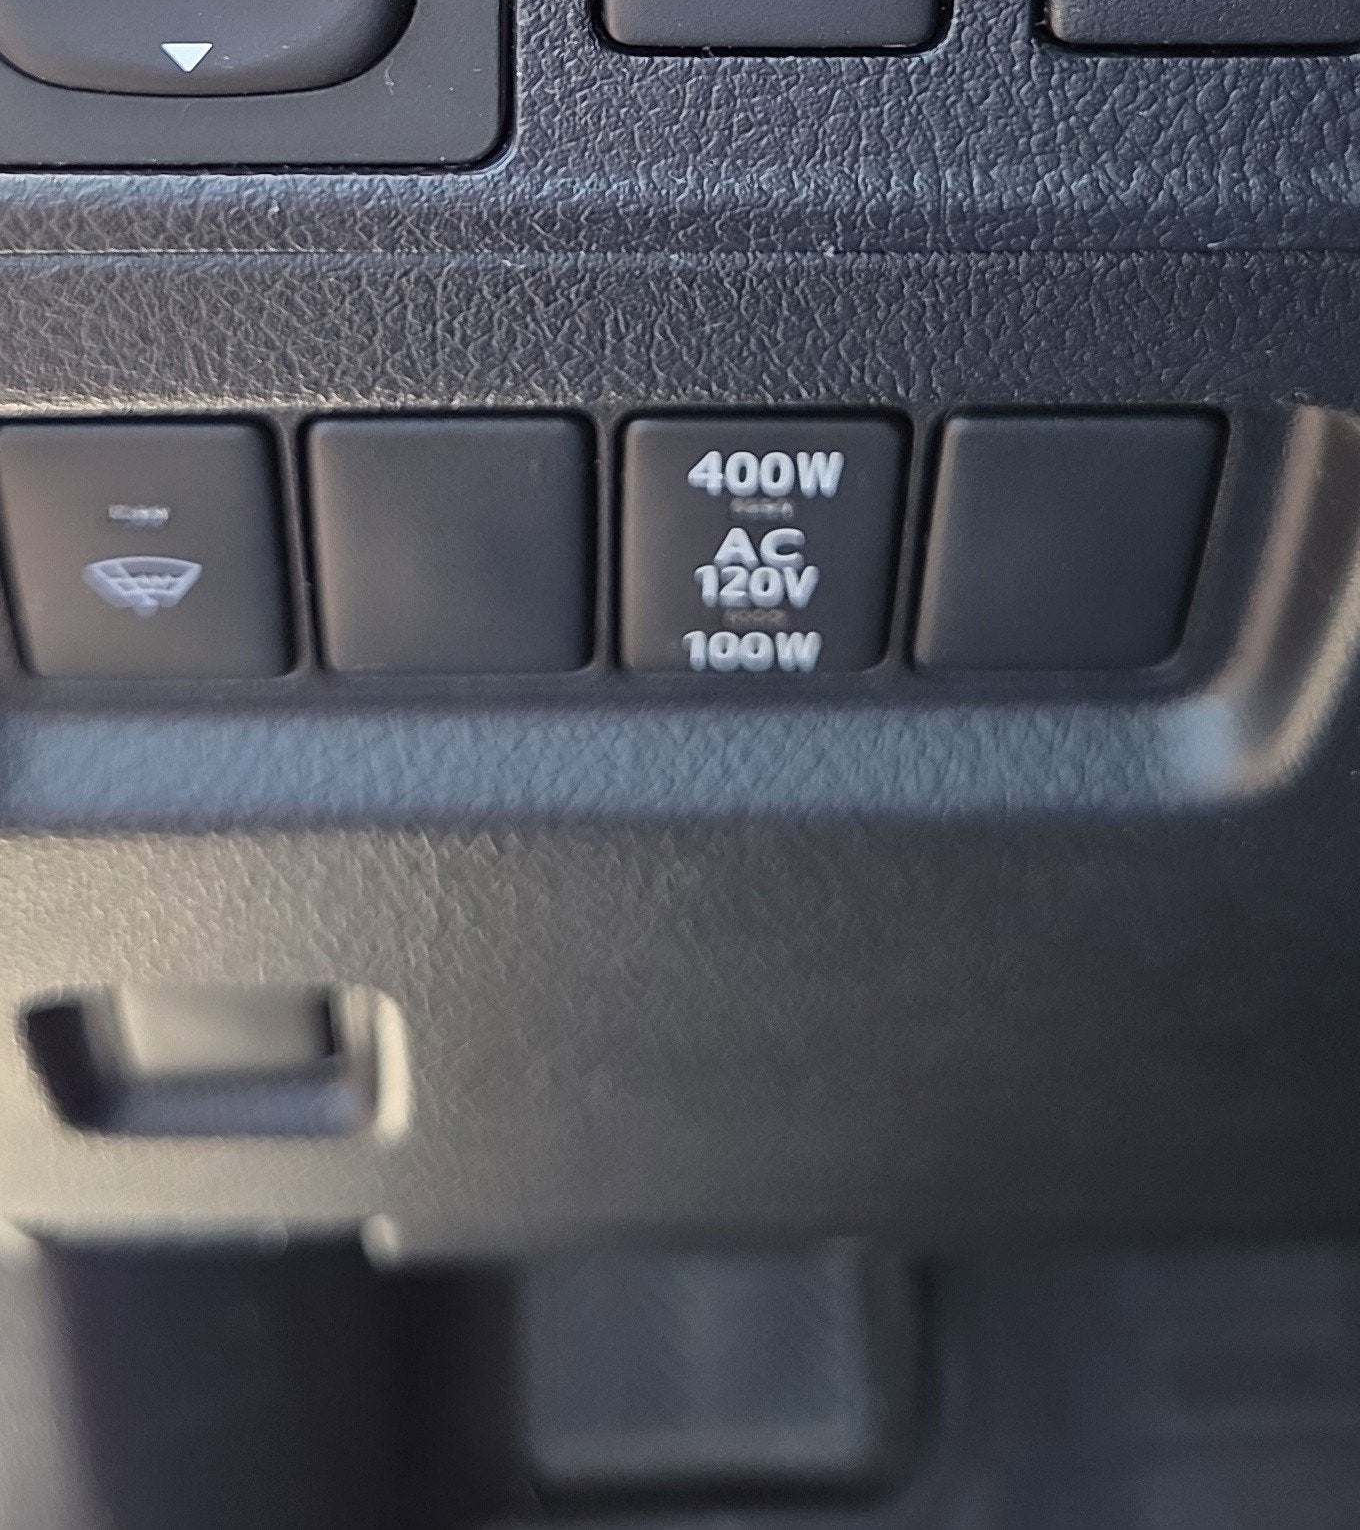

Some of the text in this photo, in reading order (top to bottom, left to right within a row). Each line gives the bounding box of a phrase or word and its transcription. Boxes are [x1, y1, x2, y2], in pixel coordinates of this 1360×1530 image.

[687, 450, 844, 498] 400W
[713, 527, 807, 568] AC
[693, 565, 820, 609] 120V
[681, 630, 823, 671] 100W
